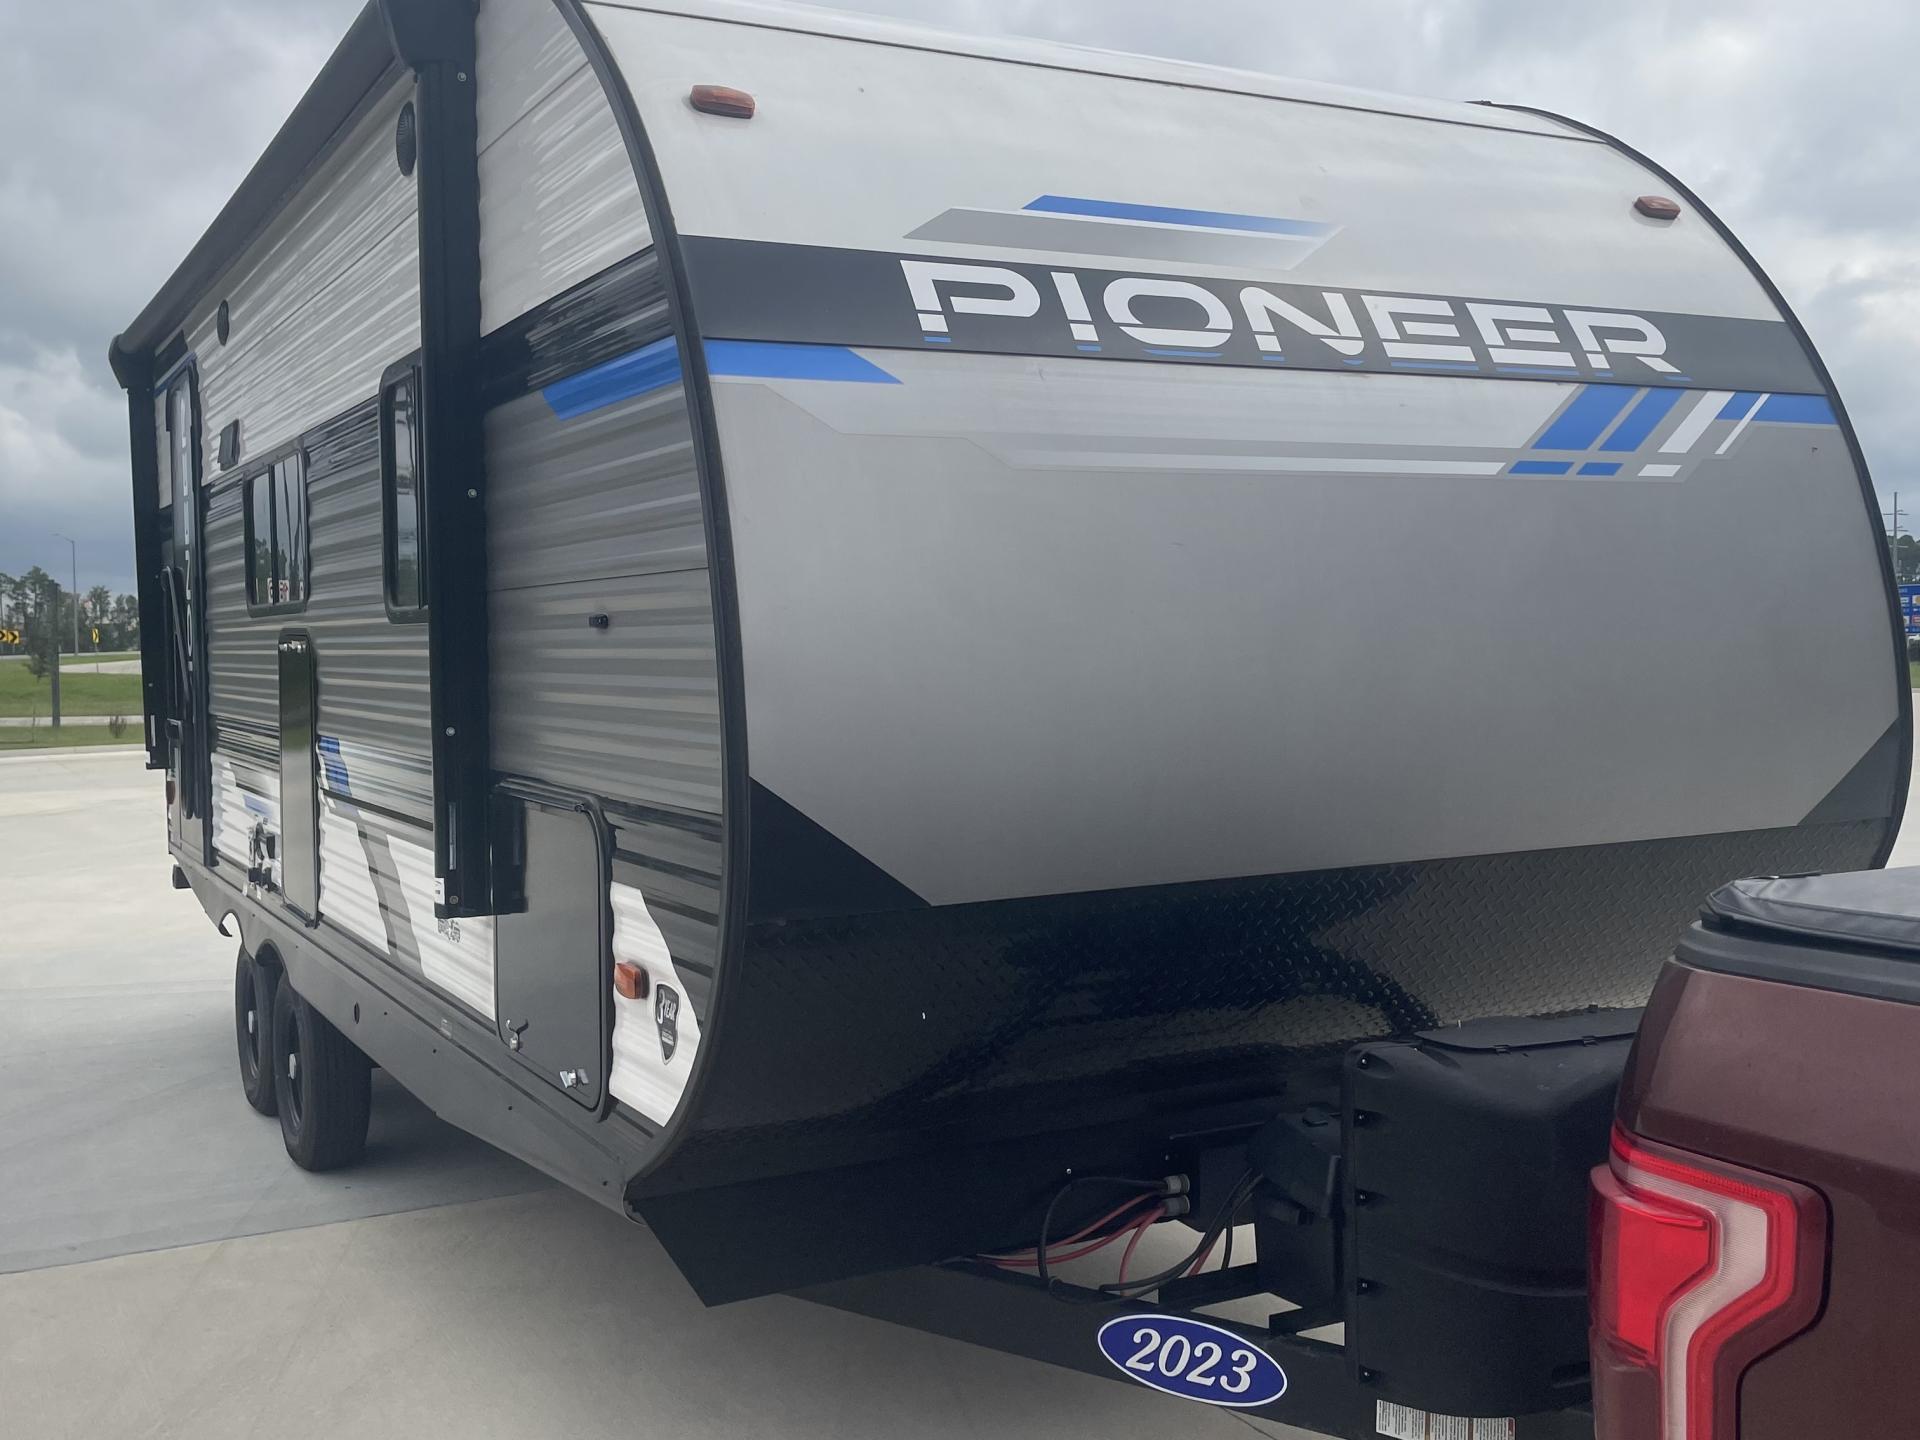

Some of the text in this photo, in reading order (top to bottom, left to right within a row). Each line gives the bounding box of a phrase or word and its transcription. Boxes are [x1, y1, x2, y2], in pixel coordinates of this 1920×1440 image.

[899, 258, 1684, 377] PIONEER
[657, 989, 677, 1024] 3 YEAR
[1125, 1327, 1258, 1394] 2023
